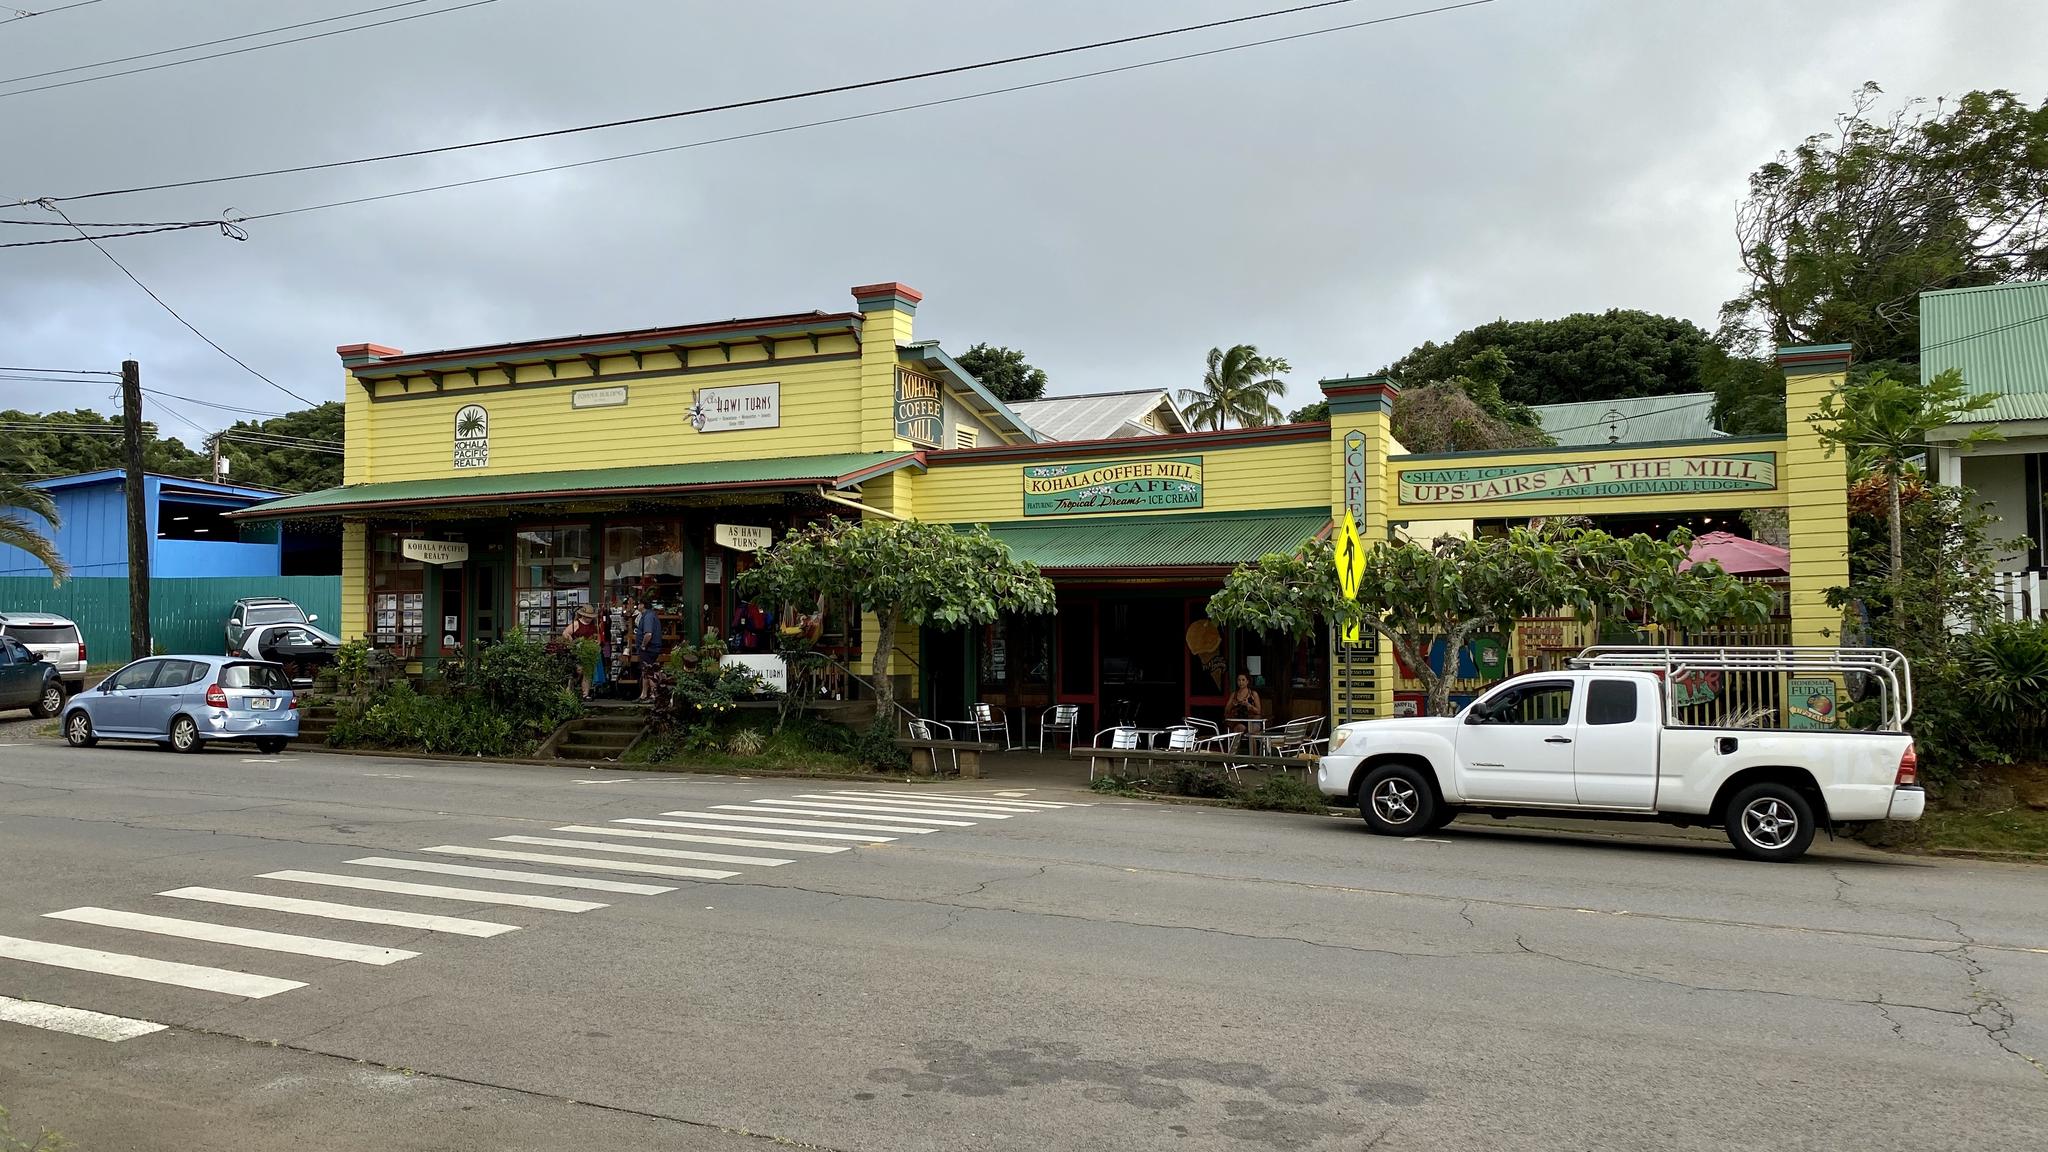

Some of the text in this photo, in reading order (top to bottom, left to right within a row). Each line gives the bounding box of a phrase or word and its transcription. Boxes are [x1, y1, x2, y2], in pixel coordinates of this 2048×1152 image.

[901, 372, 939, 400] KOHALA
[717, 396, 740, 412] HAWI
[745, 396, 771, 410] TURNS
[899, 401, 941, 419] COFFEE
[908, 419, 934, 442] MILL
[455, 440, 488, 449] KOHALA
[454, 449, 488, 458] PACIFIC
[454, 458, 487, 467] REALTY
[1032, 464, 1193, 492] KOHALA COFFEE MILL
[1413, 469, 1510, 482] SHAVE ICE
[1413, 460, 1758, 500] UPSTAIRS AT THE MILL
[1114, 480, 1176, 494] CAFE
[1347, 452, 1363, 518] CAFE
[1556, 480, 1743, 497] FINE HOMEMADE FUDGE
[1027, 492, 1198, 512] FEATURING Tropical Dreams ICE CREAM
[729, 527, 761, 538] AS HAWI
[407, 543, 436, 551] KOHALA
[732, 538, 757, 548] TURNS
[423, 552, 449, 560] REALTY
[1791, 686, 1833, 695] FUDGE
